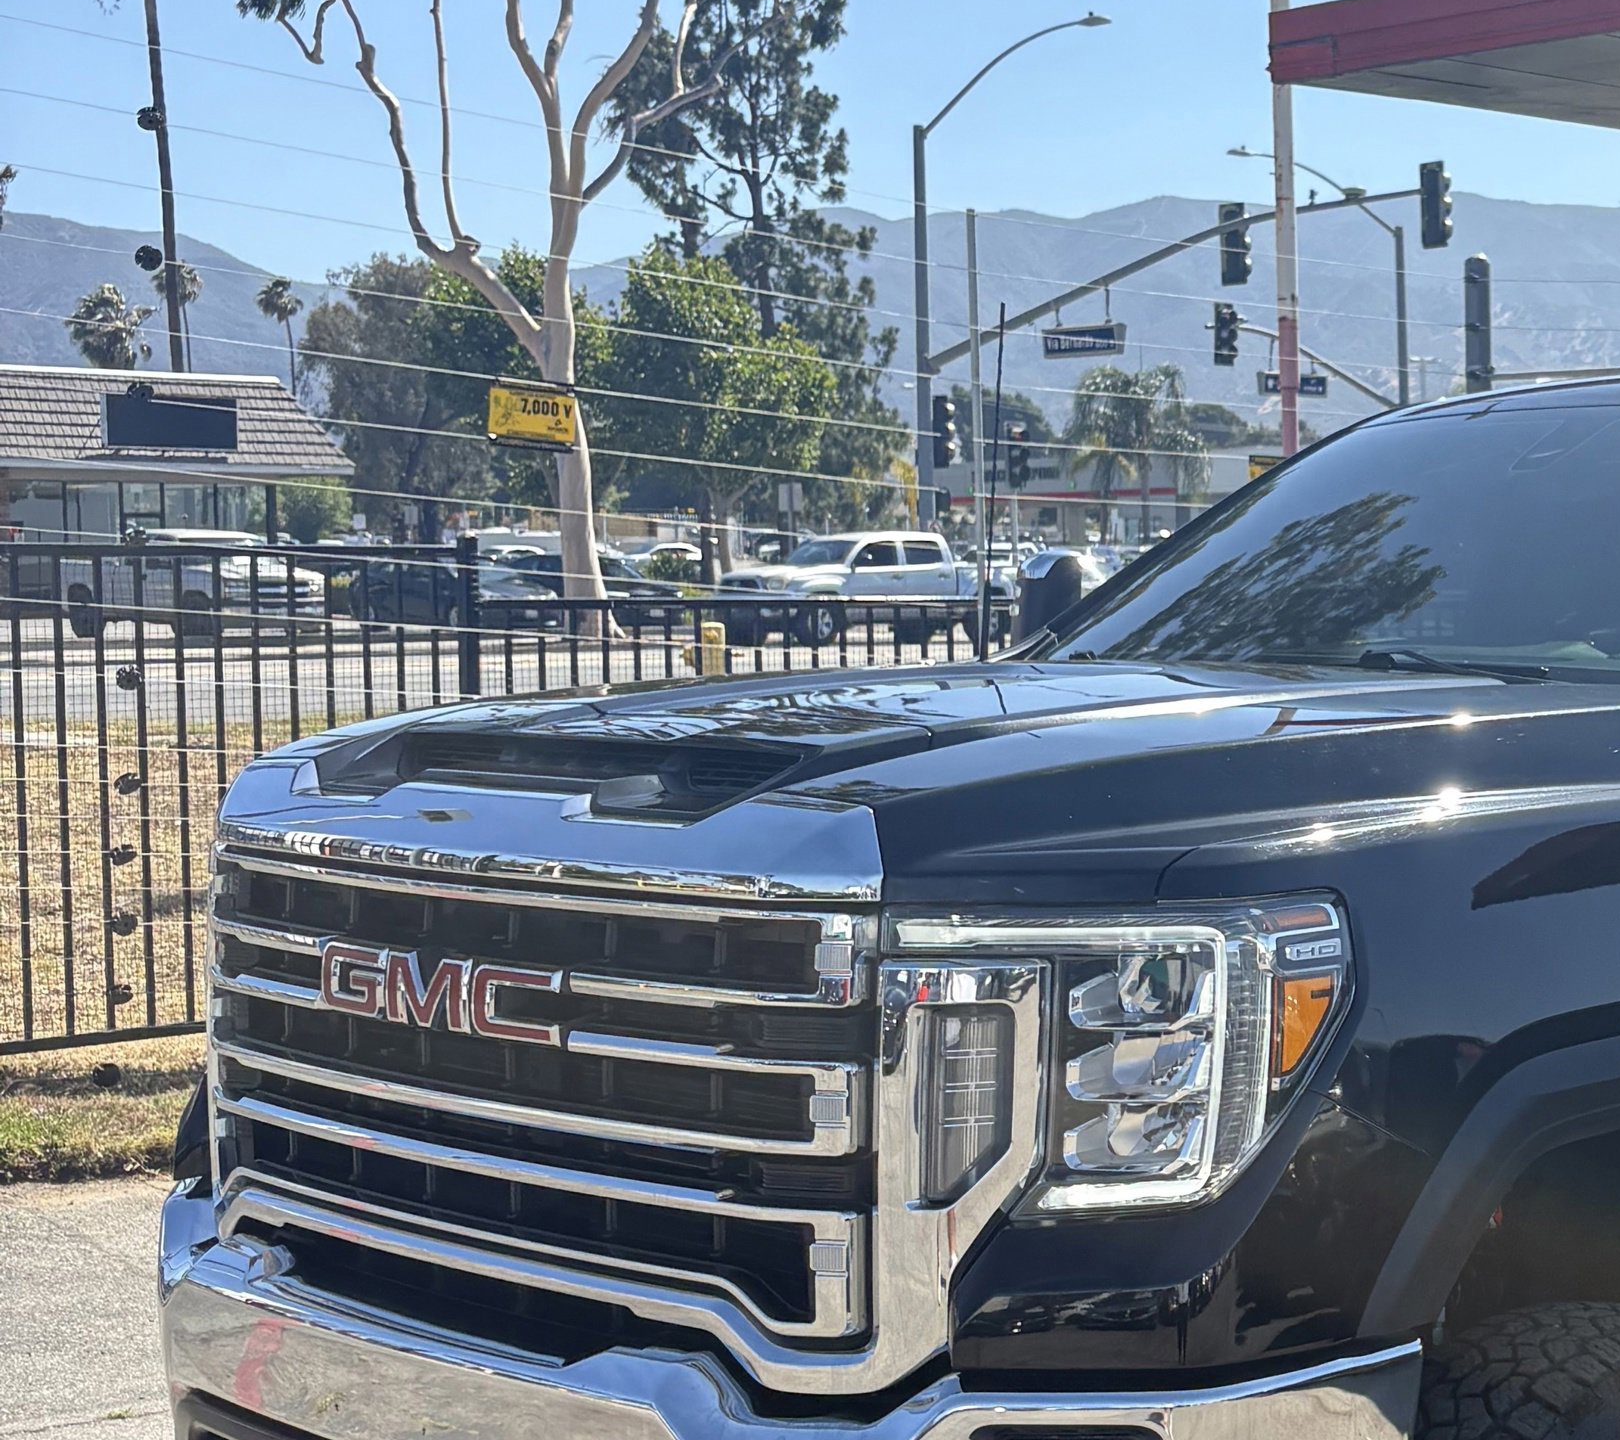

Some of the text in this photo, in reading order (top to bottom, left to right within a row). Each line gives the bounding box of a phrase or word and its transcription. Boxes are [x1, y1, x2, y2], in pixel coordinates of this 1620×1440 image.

[521, 397, 573, 420] 7,000 V
[1296, 944, 1337, 959] HD
[320, 940, 564, 1048] GMC
